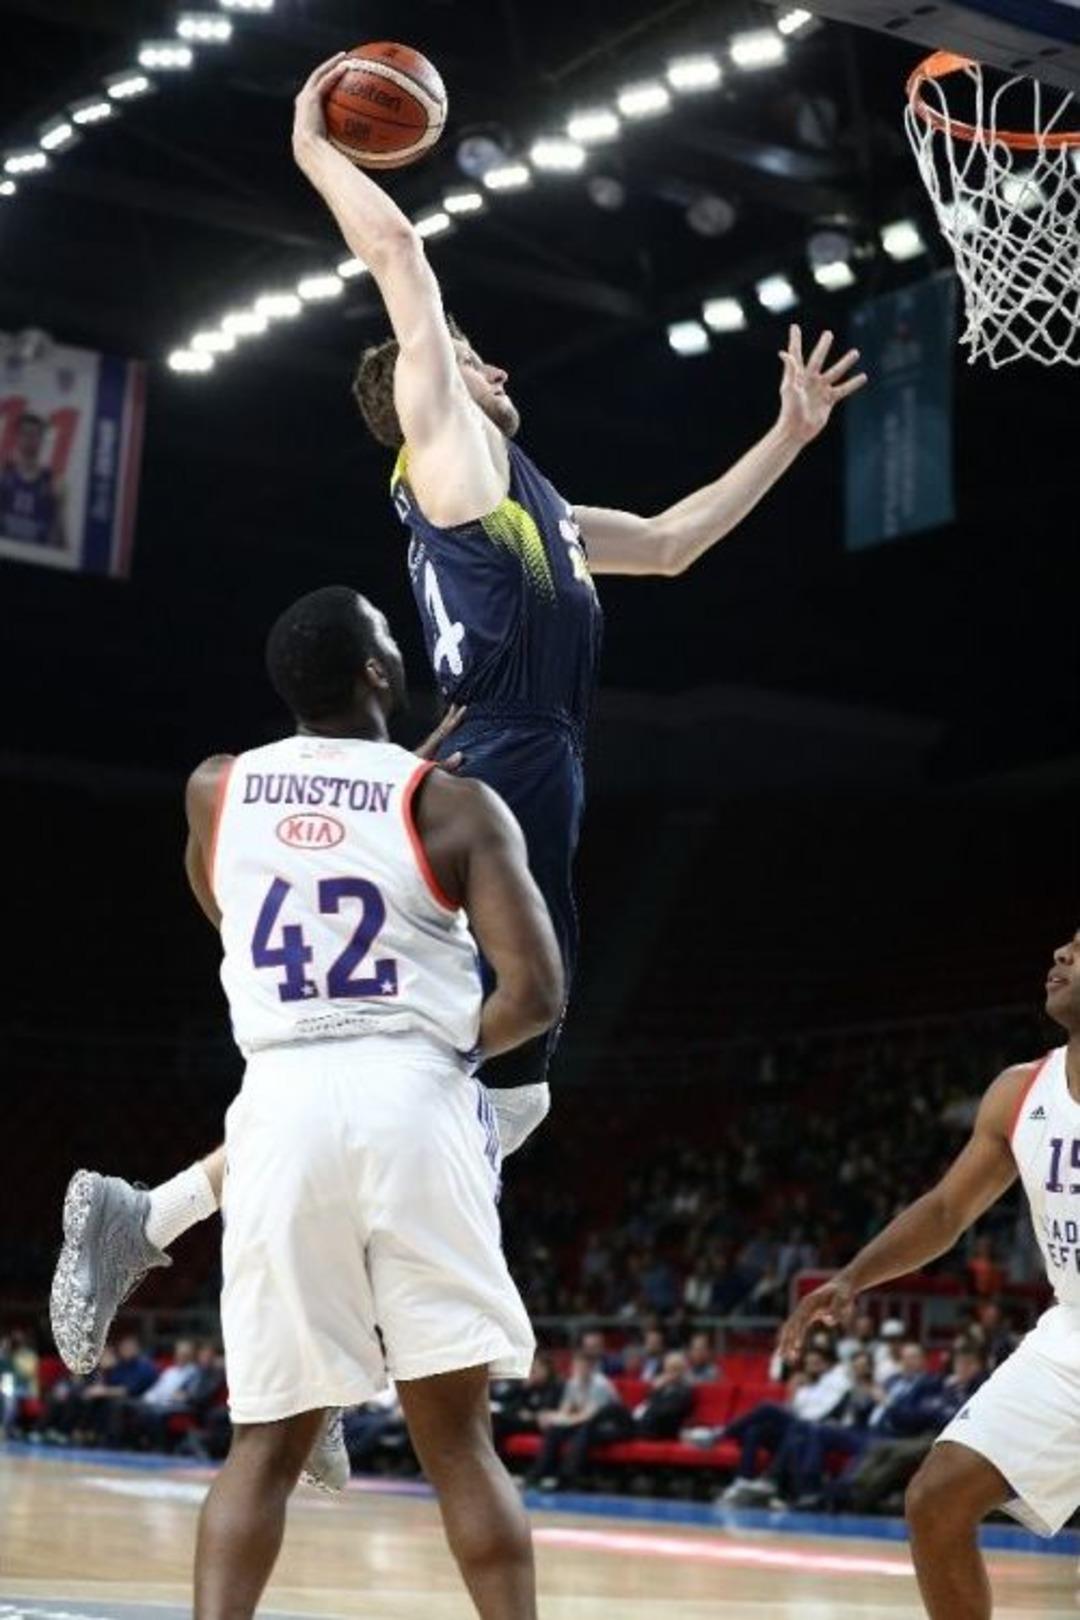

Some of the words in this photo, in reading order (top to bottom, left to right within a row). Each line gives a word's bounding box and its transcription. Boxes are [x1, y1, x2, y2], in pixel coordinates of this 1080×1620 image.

[242, 773, 396, 813] DUNSTON
[285, 818, 334, 844] KIA
[250, 876, 399, 1003] 42
